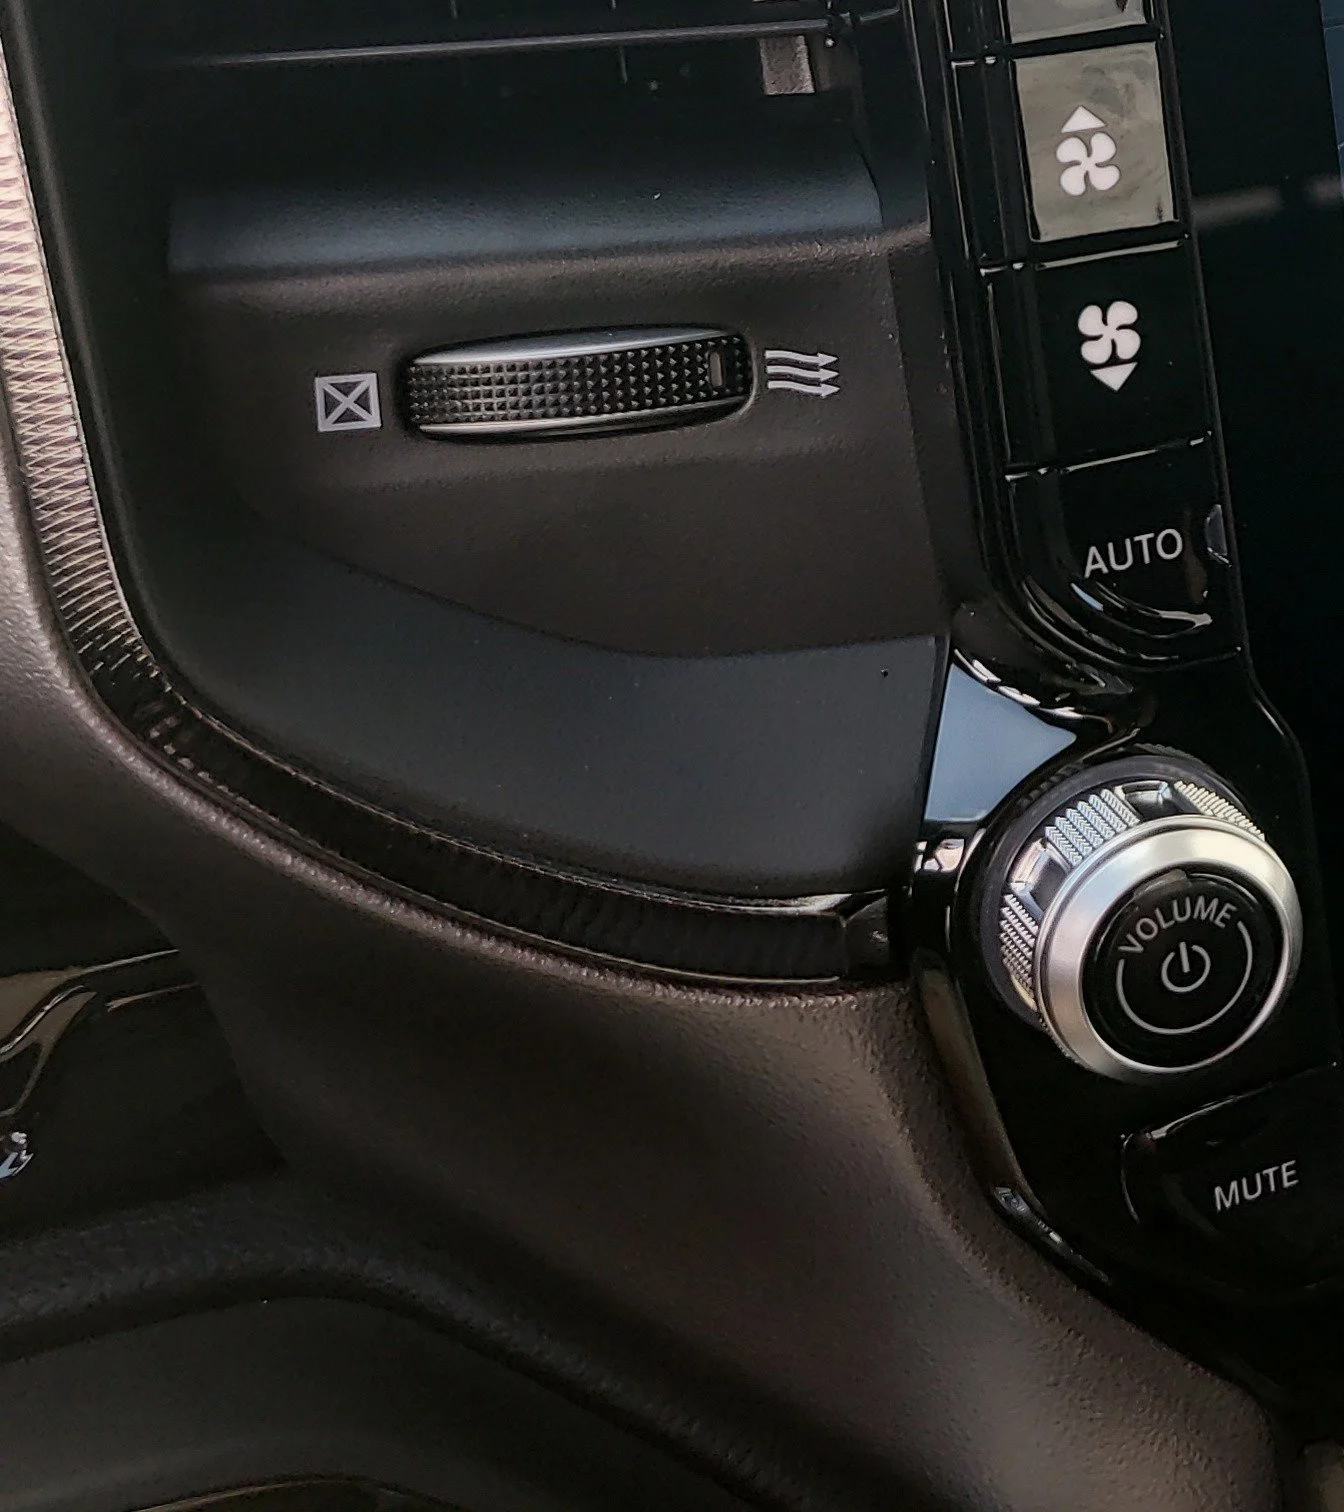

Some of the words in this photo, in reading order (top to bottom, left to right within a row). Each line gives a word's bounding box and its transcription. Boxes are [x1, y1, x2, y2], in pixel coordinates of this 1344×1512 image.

[1083, 528, 1184, 579] AUTO
[1118, 895, 1238, 954] VOLUME
[1213, 1159, 1301, 1213] MUTE
